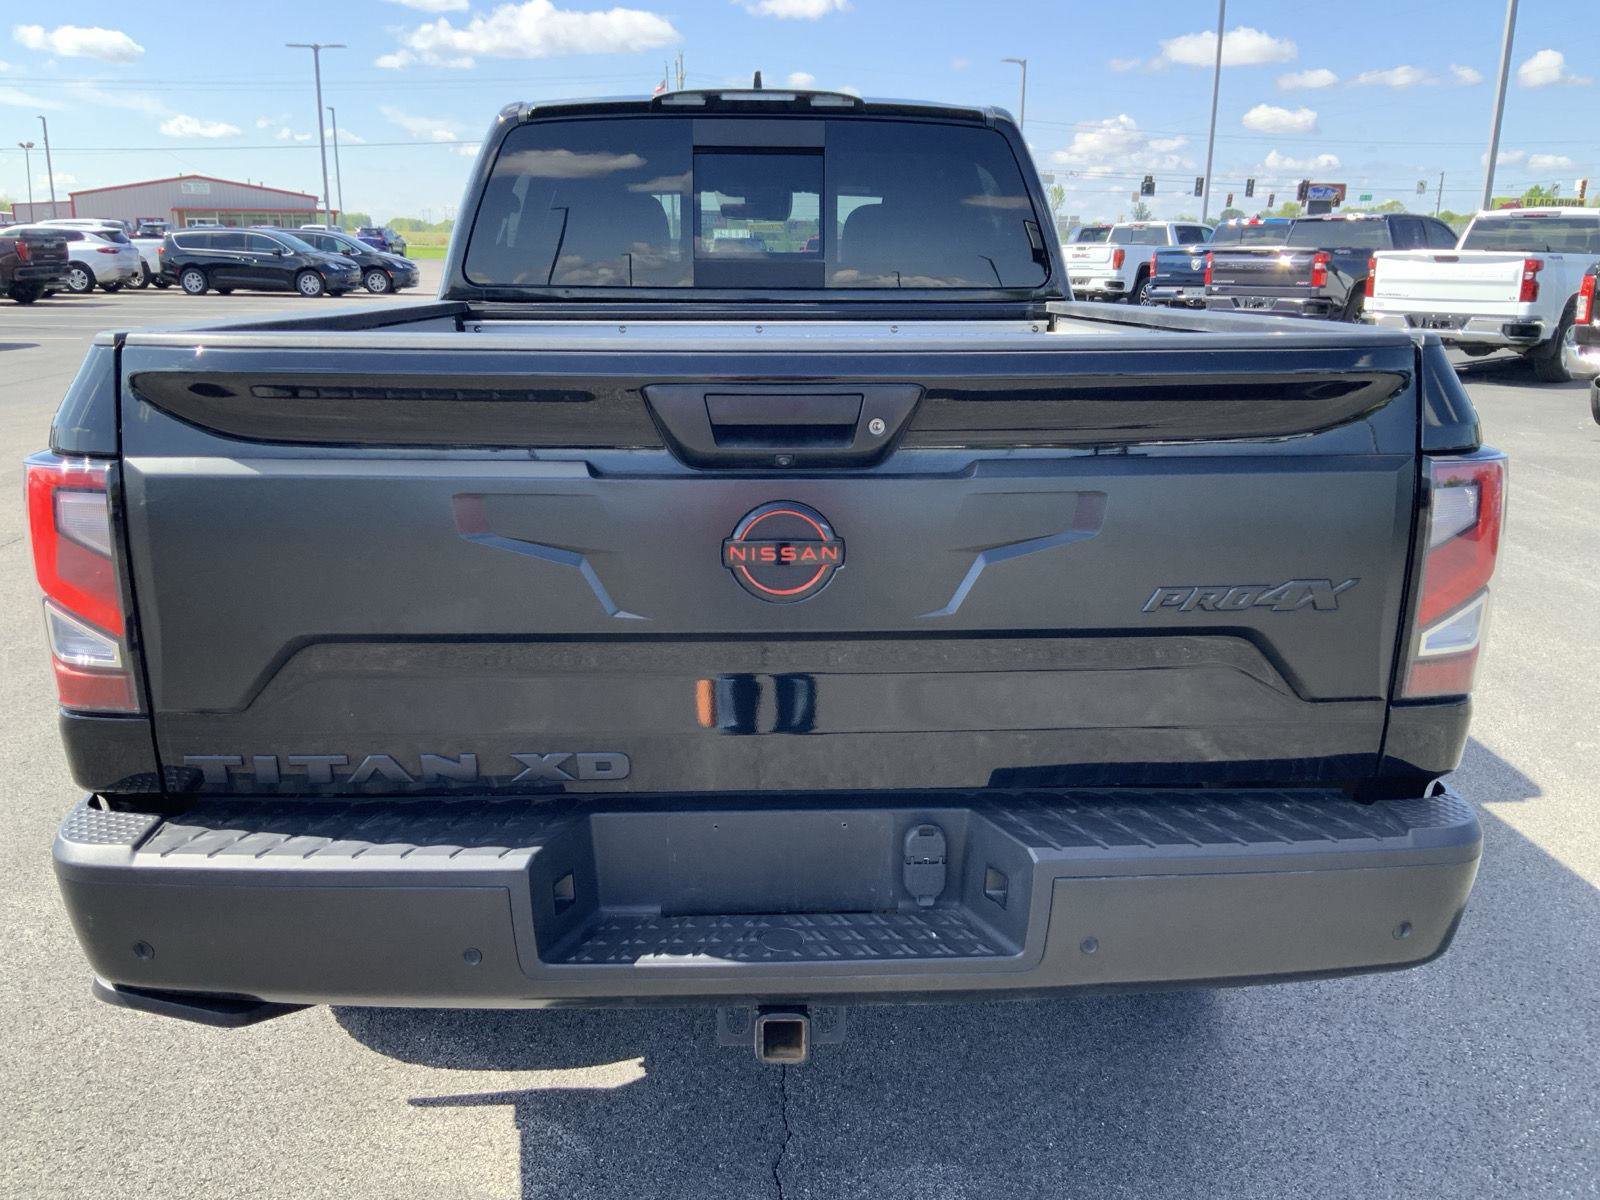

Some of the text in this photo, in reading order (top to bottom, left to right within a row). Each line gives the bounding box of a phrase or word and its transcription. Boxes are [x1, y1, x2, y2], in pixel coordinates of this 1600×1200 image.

[729, 546, 838, 562] NISSAN
[183, 752, 632, 784] TITAN XD
